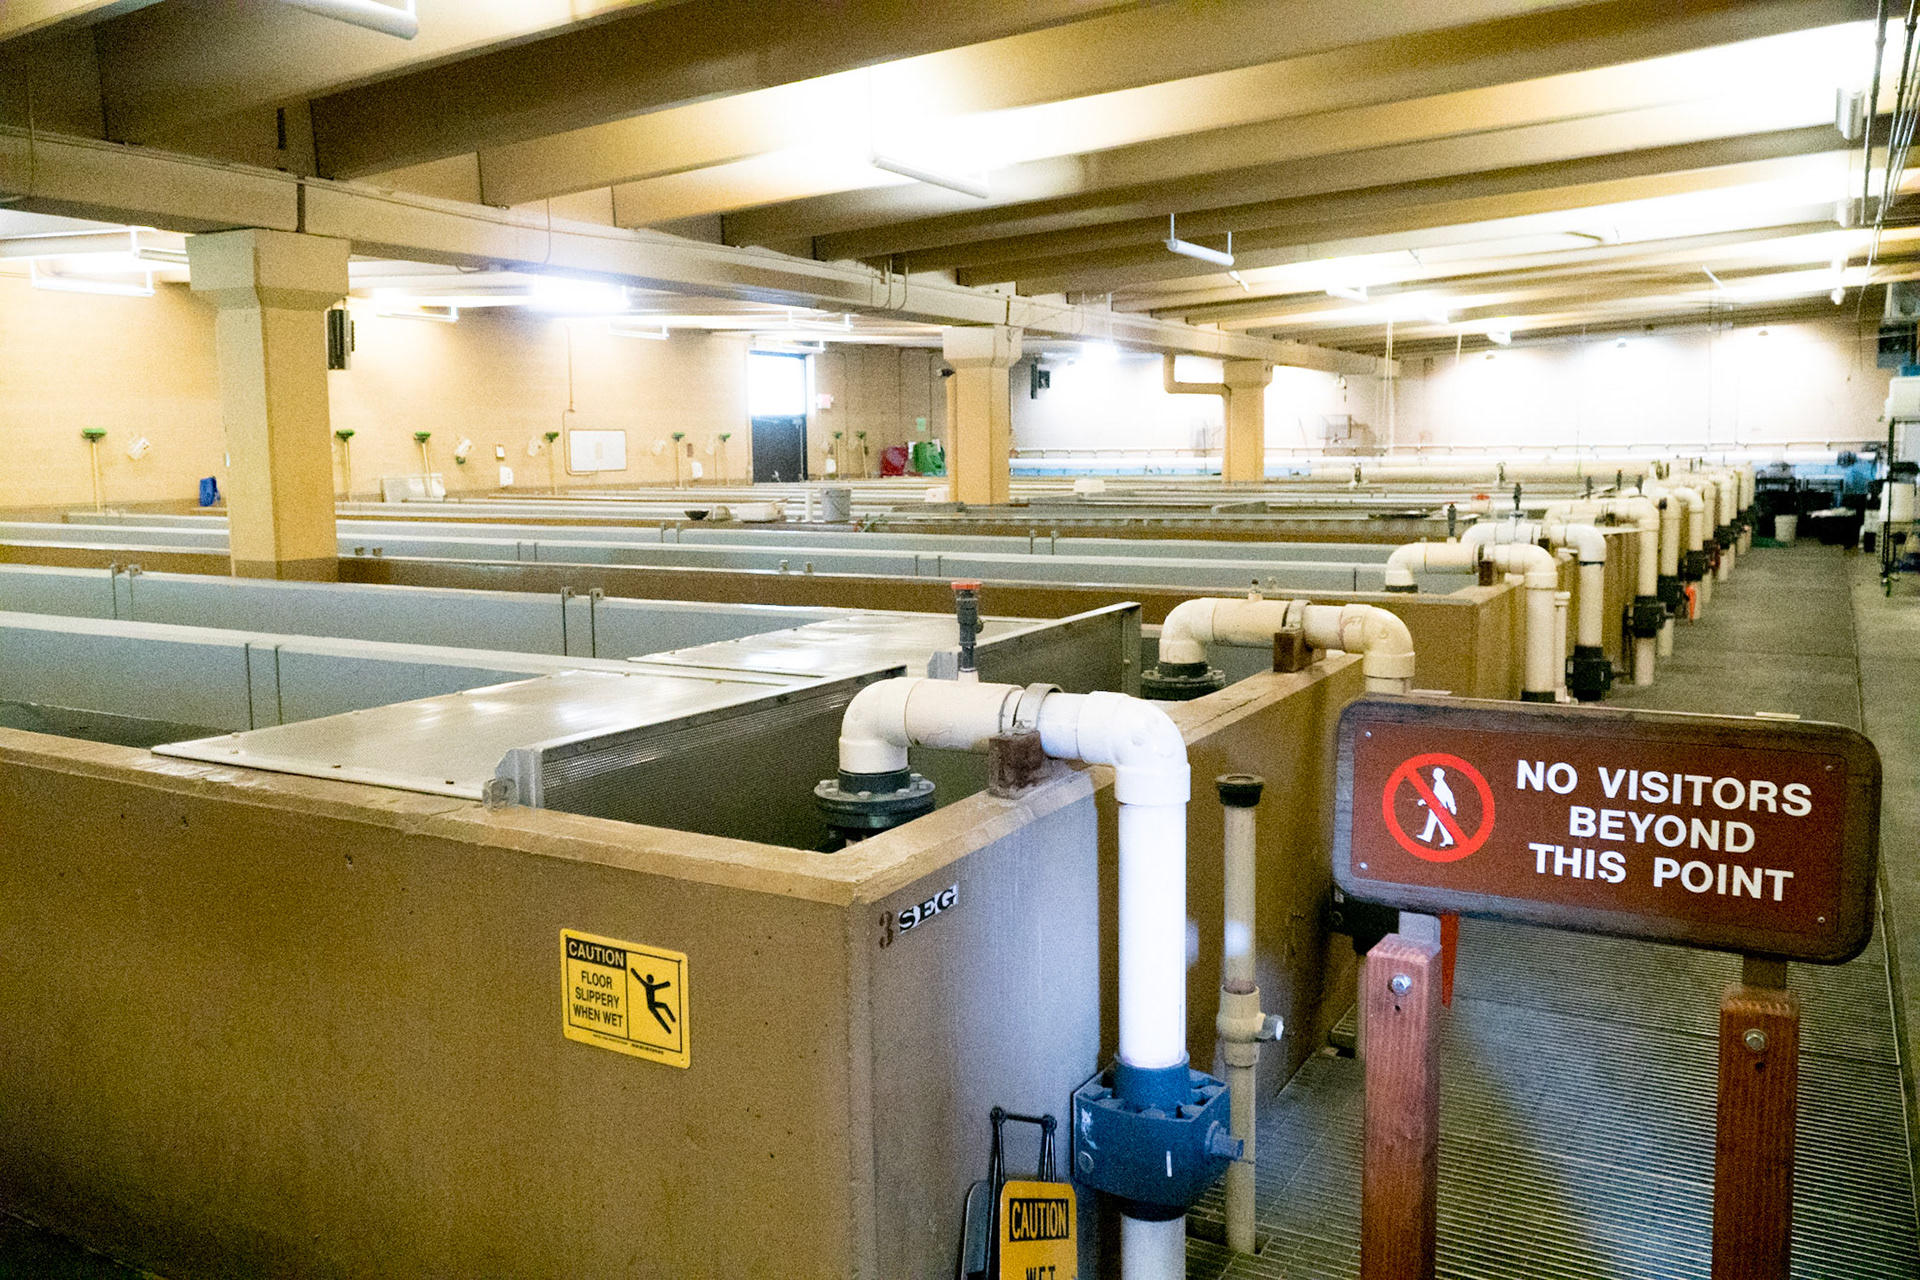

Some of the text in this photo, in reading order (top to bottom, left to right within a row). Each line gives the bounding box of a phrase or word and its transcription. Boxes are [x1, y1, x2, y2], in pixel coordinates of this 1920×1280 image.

[1516, 759, 1813, 817] NO VISITORS
[1569, 805, 1756, 853] BEYOND
[1528, 842, 1795, 902] THIS POINT
[879, 889, 957, 950] 3 SEG
[568, 941, 624, 967] CAUTION
[575, 986, 620, 1009] SLIPPERY
[581, 970, 613, 990] FLOOR
[573, 1003, 623, 1028] WHEN WET
[1011, 1201, 1067, 1240] CAUTION
